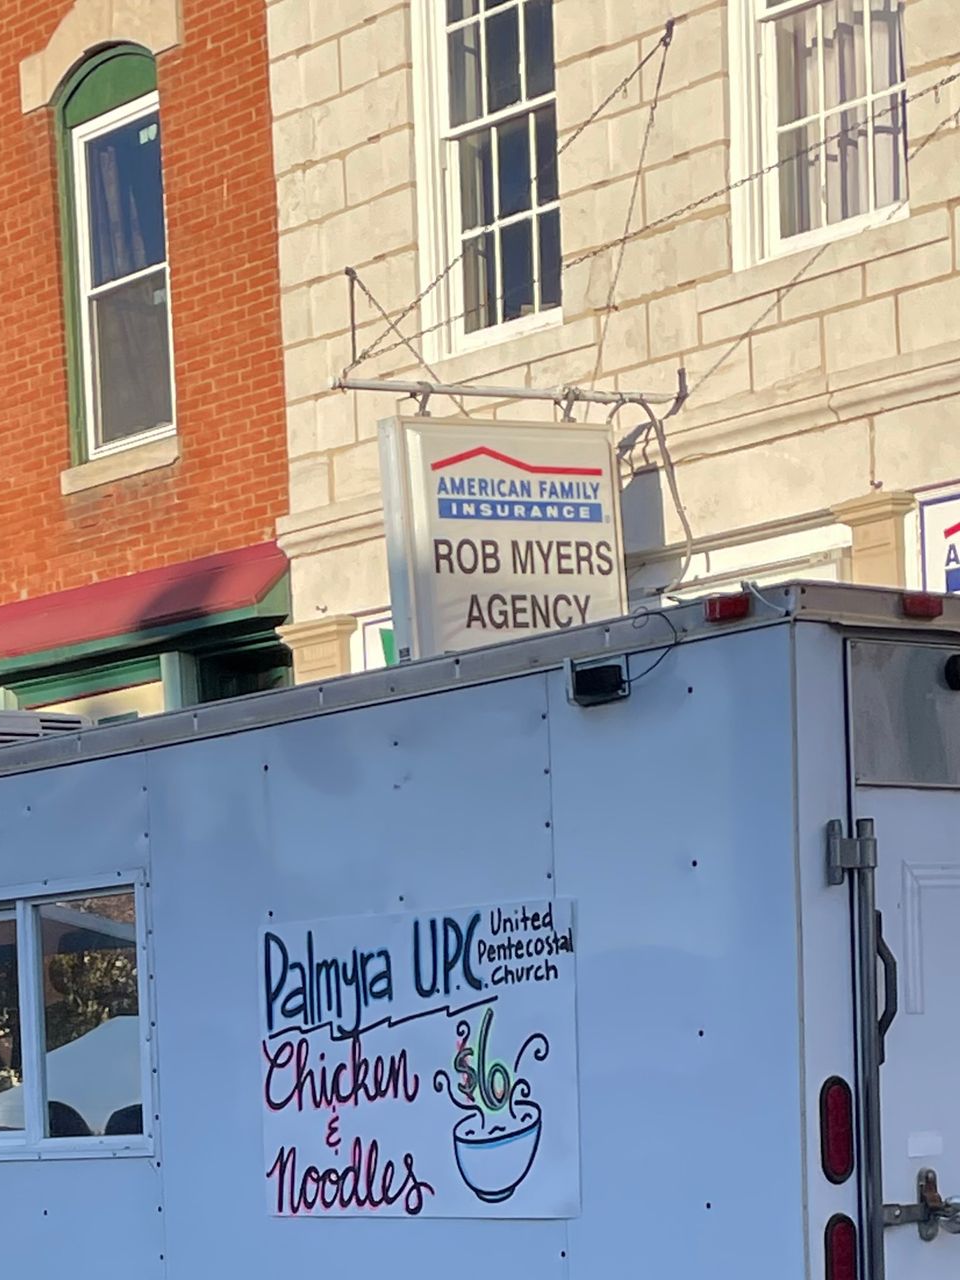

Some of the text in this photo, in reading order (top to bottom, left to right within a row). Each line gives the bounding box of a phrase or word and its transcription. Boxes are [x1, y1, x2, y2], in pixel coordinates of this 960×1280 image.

[437, 476, 600, 500] AMERICAN FAMILY
[451, 502, 590, 519] INSURANCE
[433, 538, 613, 576] ROB MYERS
[466, 593, 590, 629] AGENCY
[491, 902, 553, 936] United
[478, 928, 573, 965] Pentecostal
[264, 930, 393, 1036] Palmyra
[492, 959, 558, 985] Church
[263, 1035, 419, 1111] Chicken
[454, 1007, 510, 1111] $6
[326, 1105, 341, 1155] &
[266, 1137, 435, 1215] Noodles
